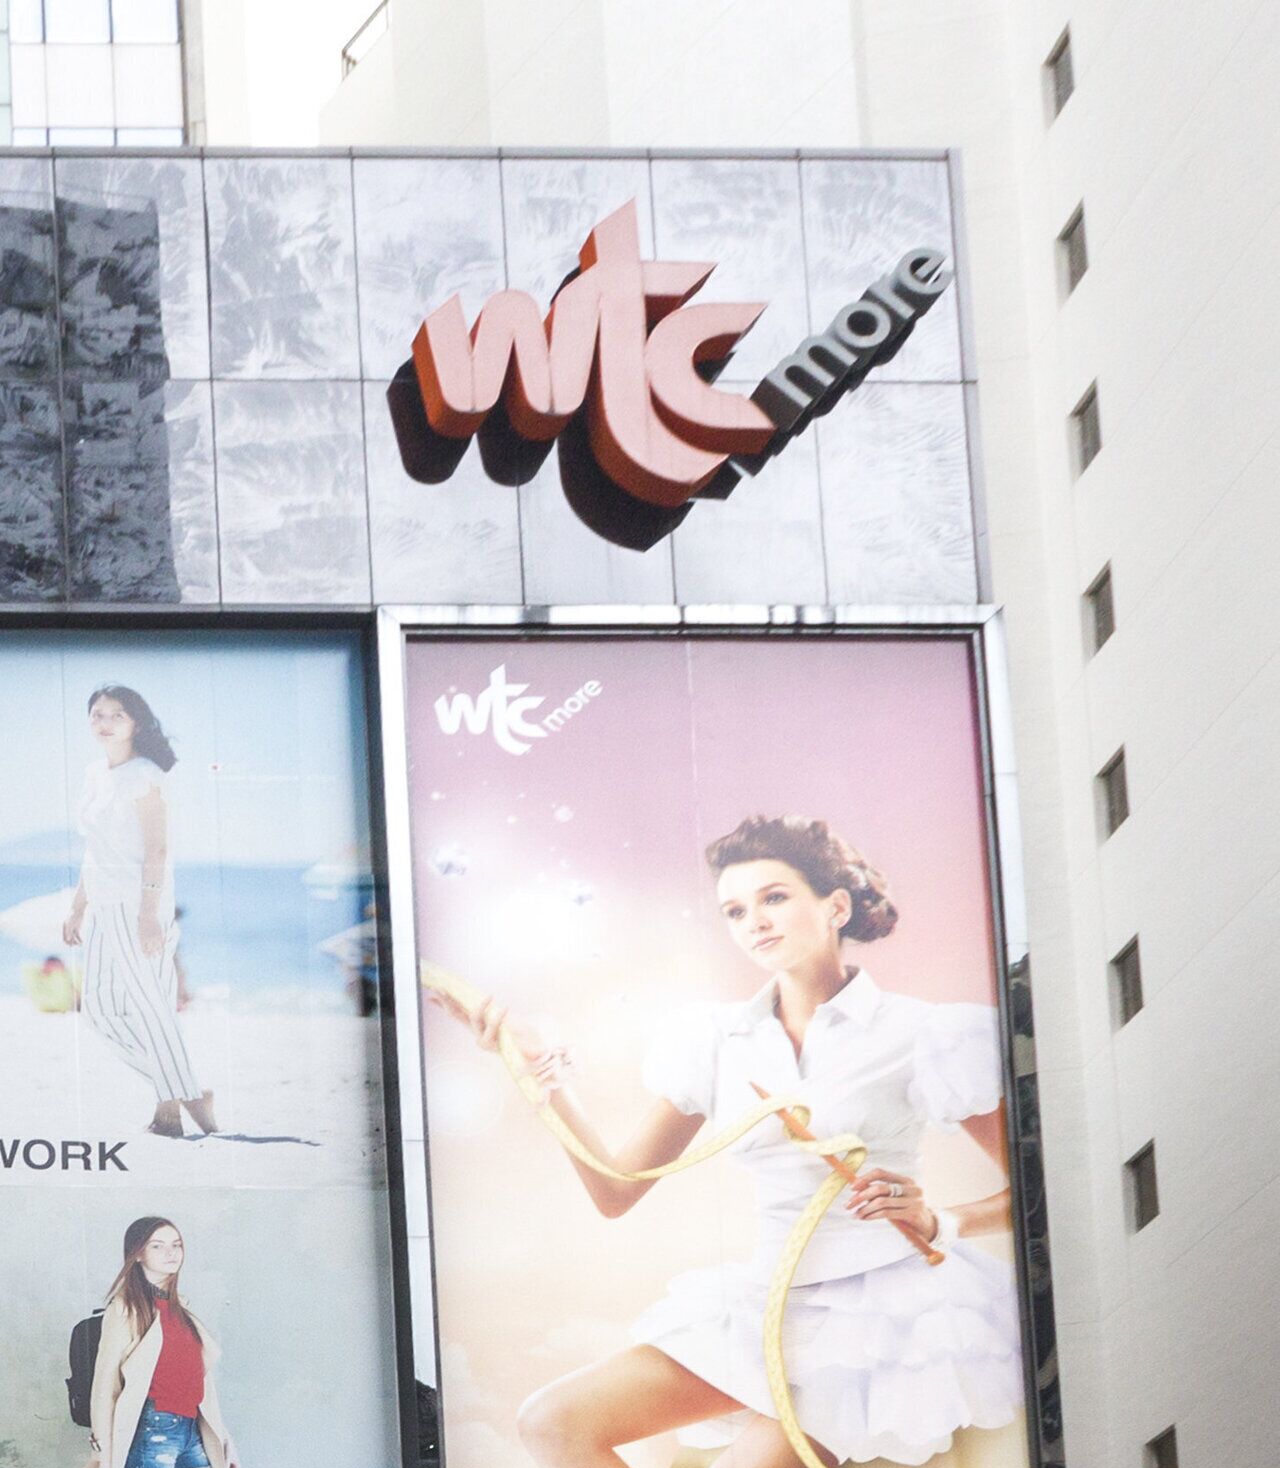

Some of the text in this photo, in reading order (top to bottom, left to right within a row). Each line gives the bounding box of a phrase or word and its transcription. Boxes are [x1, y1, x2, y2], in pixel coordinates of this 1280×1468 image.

[402, 196, 953, 520] wtc more
[434, 664, 603, 756] wtc more
